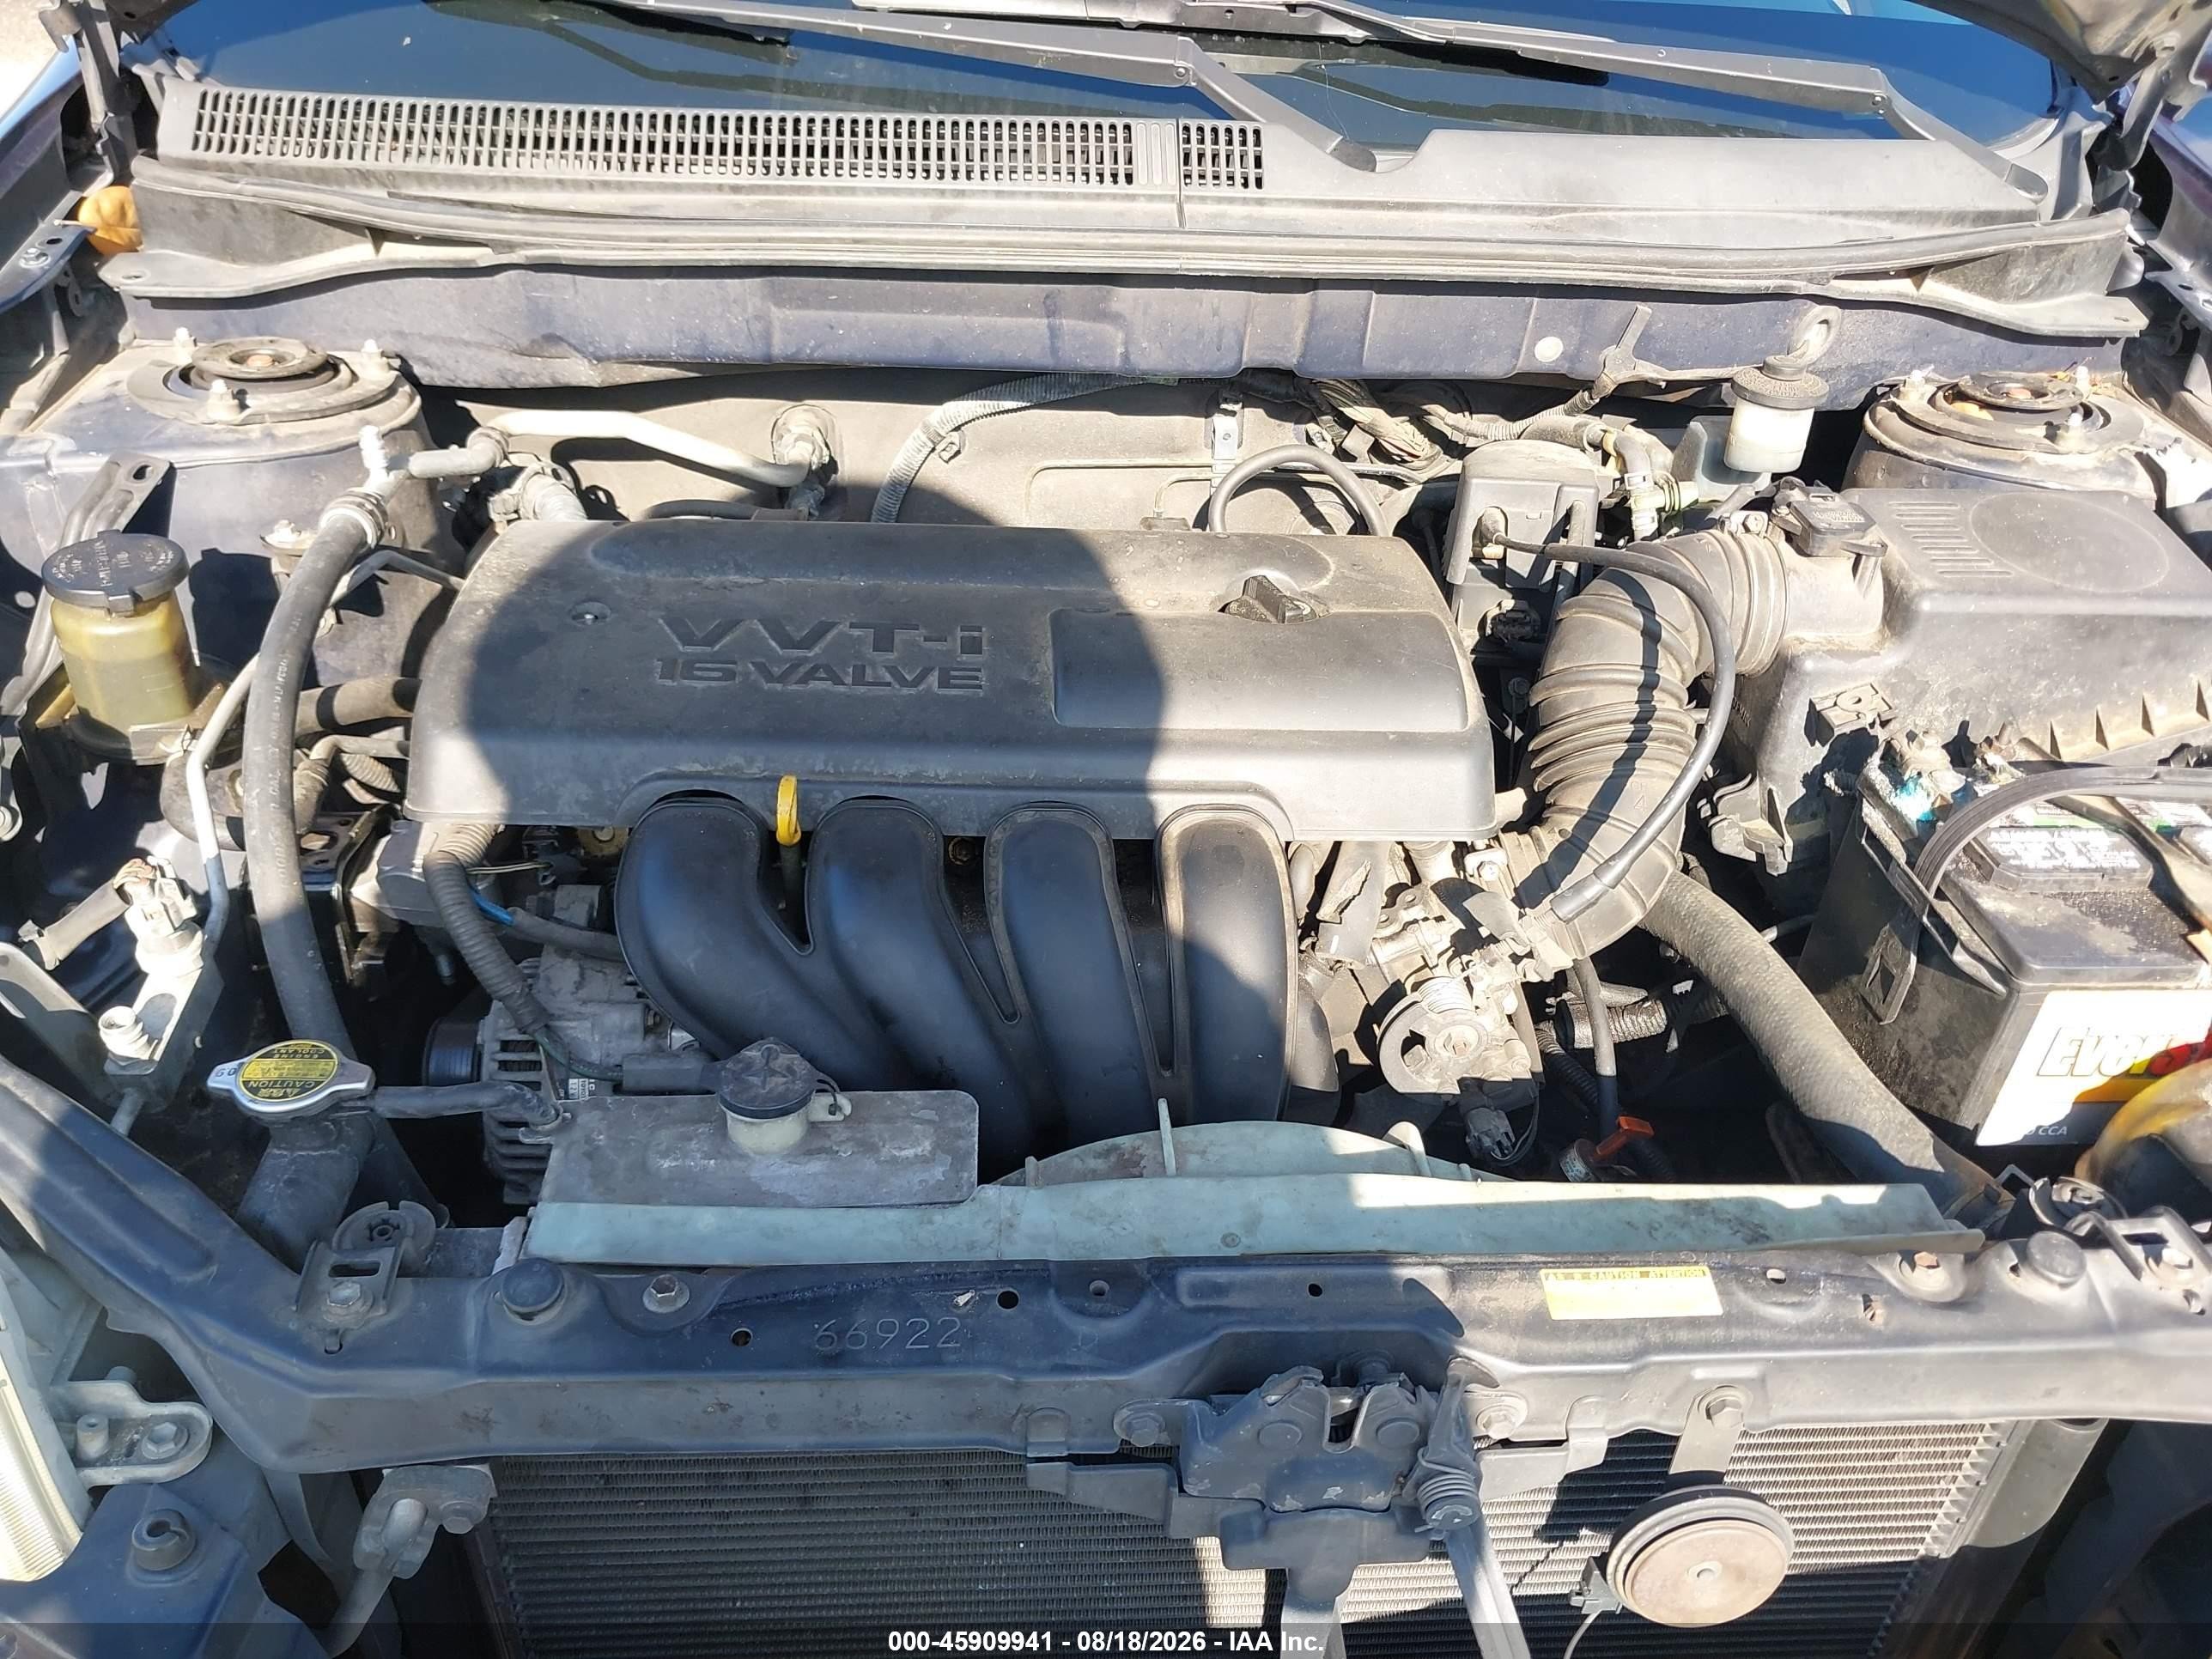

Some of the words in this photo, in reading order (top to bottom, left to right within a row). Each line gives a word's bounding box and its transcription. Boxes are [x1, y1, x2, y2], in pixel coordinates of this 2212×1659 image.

[657, 617, 985, 657] VVT-i
[657, 658, 738, 683] 16
[749, 660, 984, 692] VALVE
[248, 1079, 316, 1089] CAUTION
[2038, 1126, 2068, 1136] CCA
[813, 1316, 962, 1351] 66922
